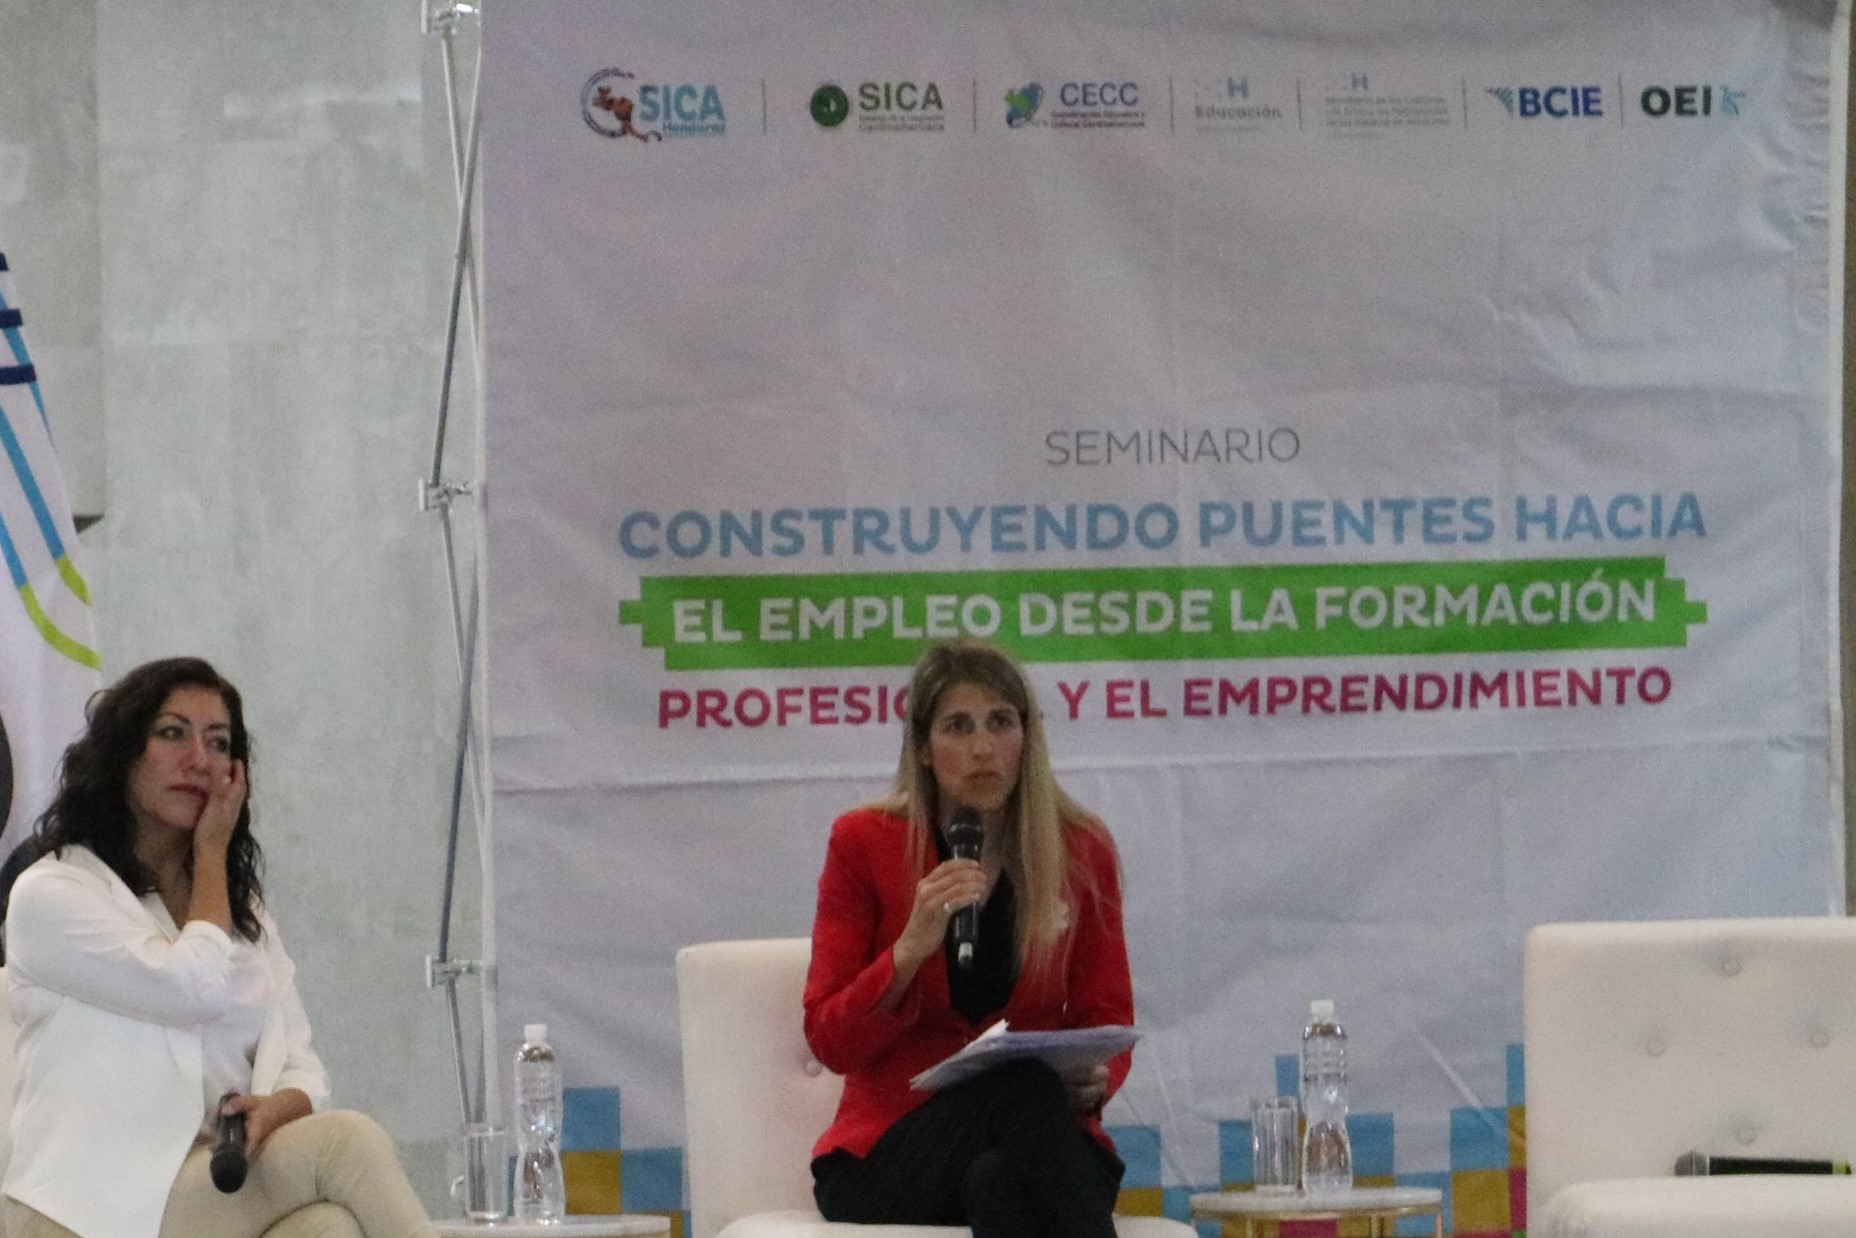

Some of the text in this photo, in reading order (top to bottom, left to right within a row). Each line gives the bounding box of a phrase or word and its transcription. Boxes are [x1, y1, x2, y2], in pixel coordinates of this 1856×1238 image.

[638, 84, 726, 122] SICA
[858, 81, 944, 111] SICA
[1060, 81, 1139, 107] CECC
[1518, 86, 1603, 118] BCIE
[1641, 85, 1713, 118] OEI
[1044, 427, 1301, 467] SEMINARIO
[618, 491, 1708, 559] CONSTRUYENDO PUENTES HACIA
[672, 568, 1655, 643] EL EMPLEO DESDE LA FORMACIÓN
[658, 666, 1672, 730] PROFESI Y EL EMPRENDIMIENTO
